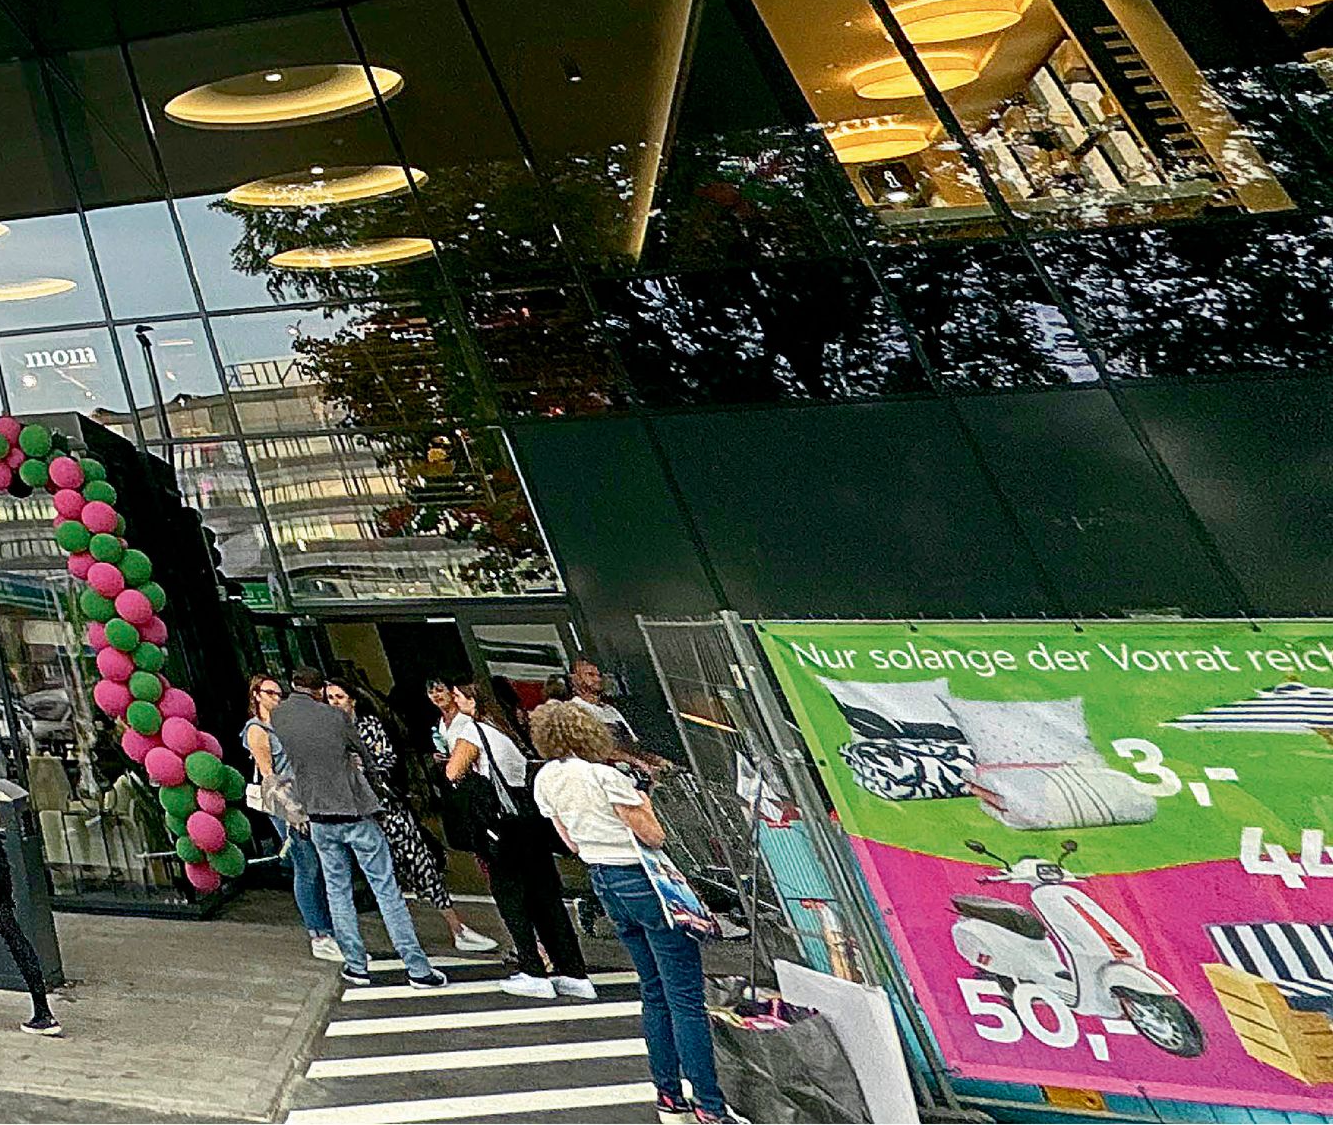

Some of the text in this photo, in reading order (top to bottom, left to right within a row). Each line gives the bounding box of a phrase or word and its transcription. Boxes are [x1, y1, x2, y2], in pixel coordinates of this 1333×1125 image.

[791, 642, 858, 672] Nur
[869, 642, 1017, 678] solange
[1027, 644, 1091, 673] der
[1099, 643, 1241, 674] Vorrat
[1111, 738, 1239, 807] 3,-
[957, 977, 1139, 1061] 50,-
